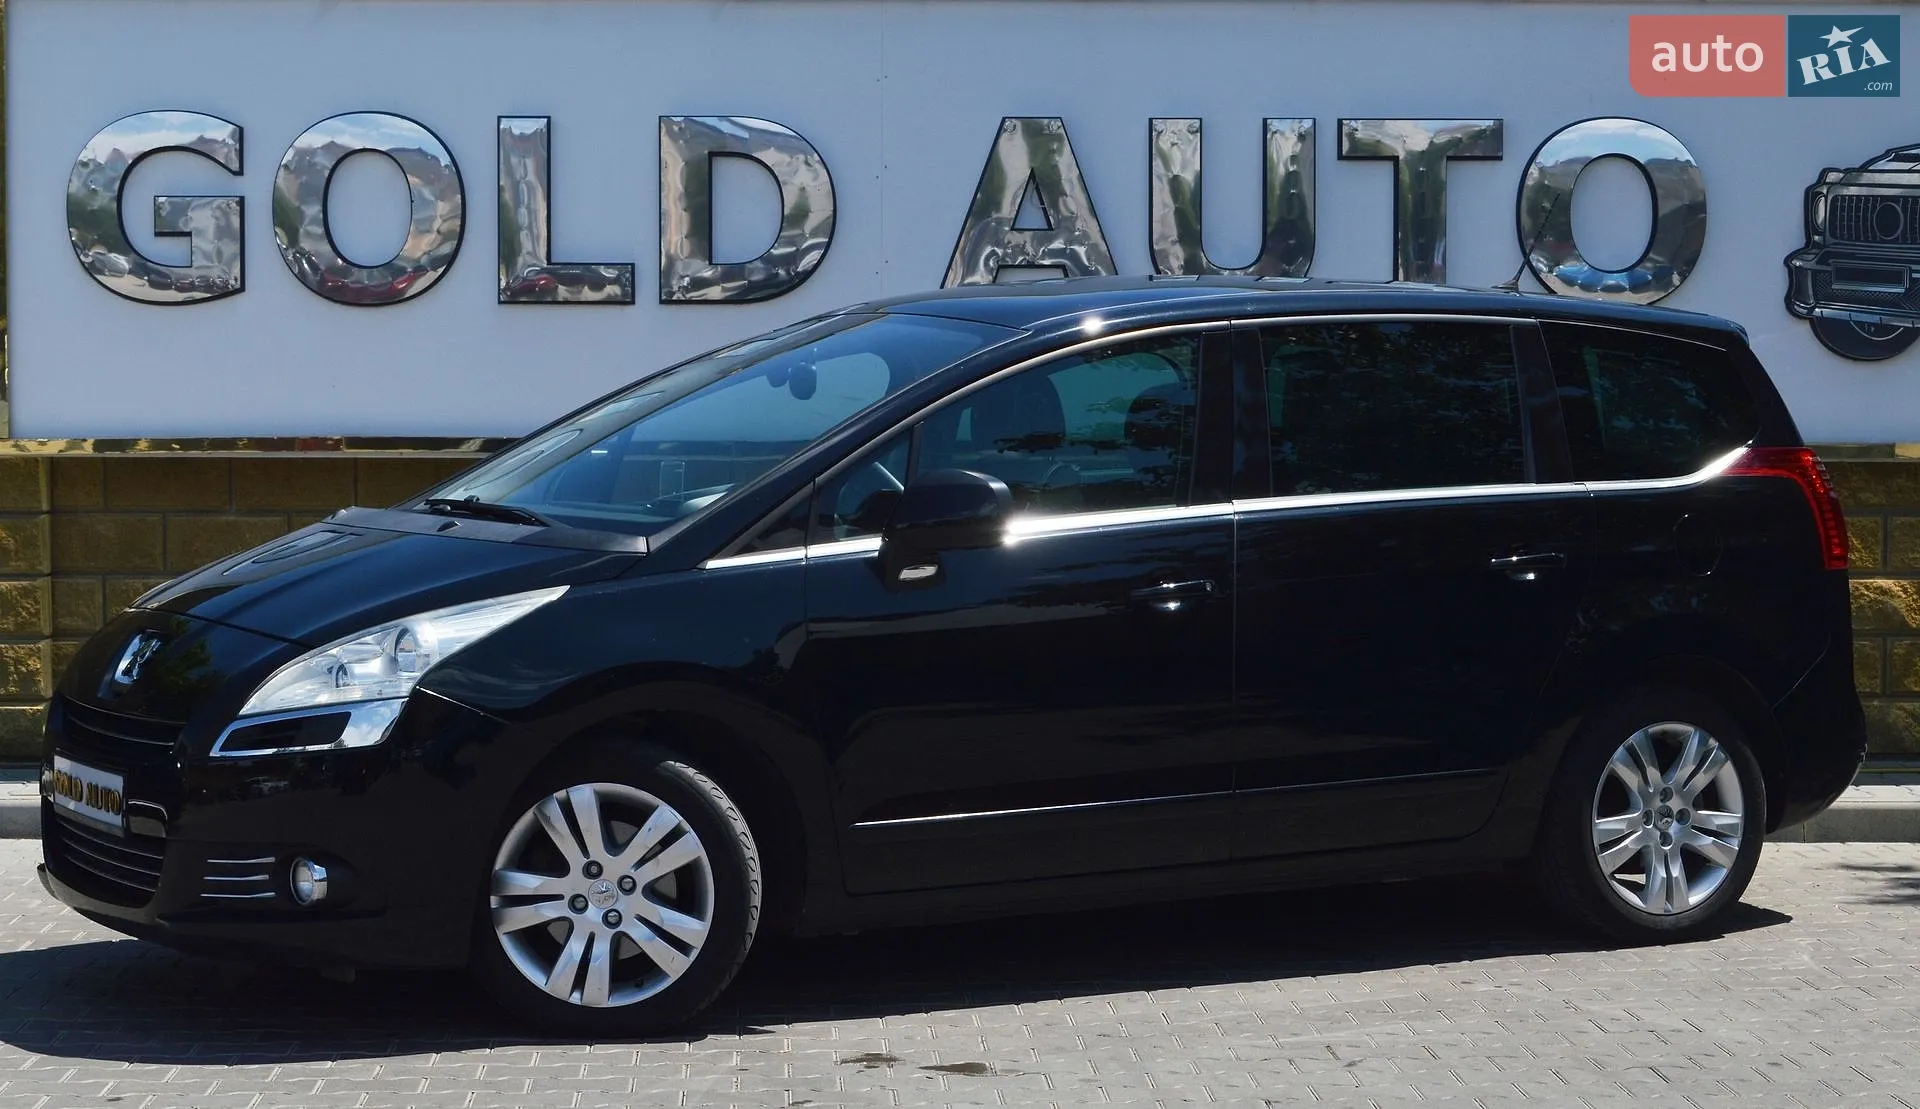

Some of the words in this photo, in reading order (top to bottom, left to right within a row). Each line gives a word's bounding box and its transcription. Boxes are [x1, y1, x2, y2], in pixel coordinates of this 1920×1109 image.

[66, 109, 838, 306] GOLD
[942, 116, 1709, 306] AUTO
[86, 782, 122, 816] AUTO
